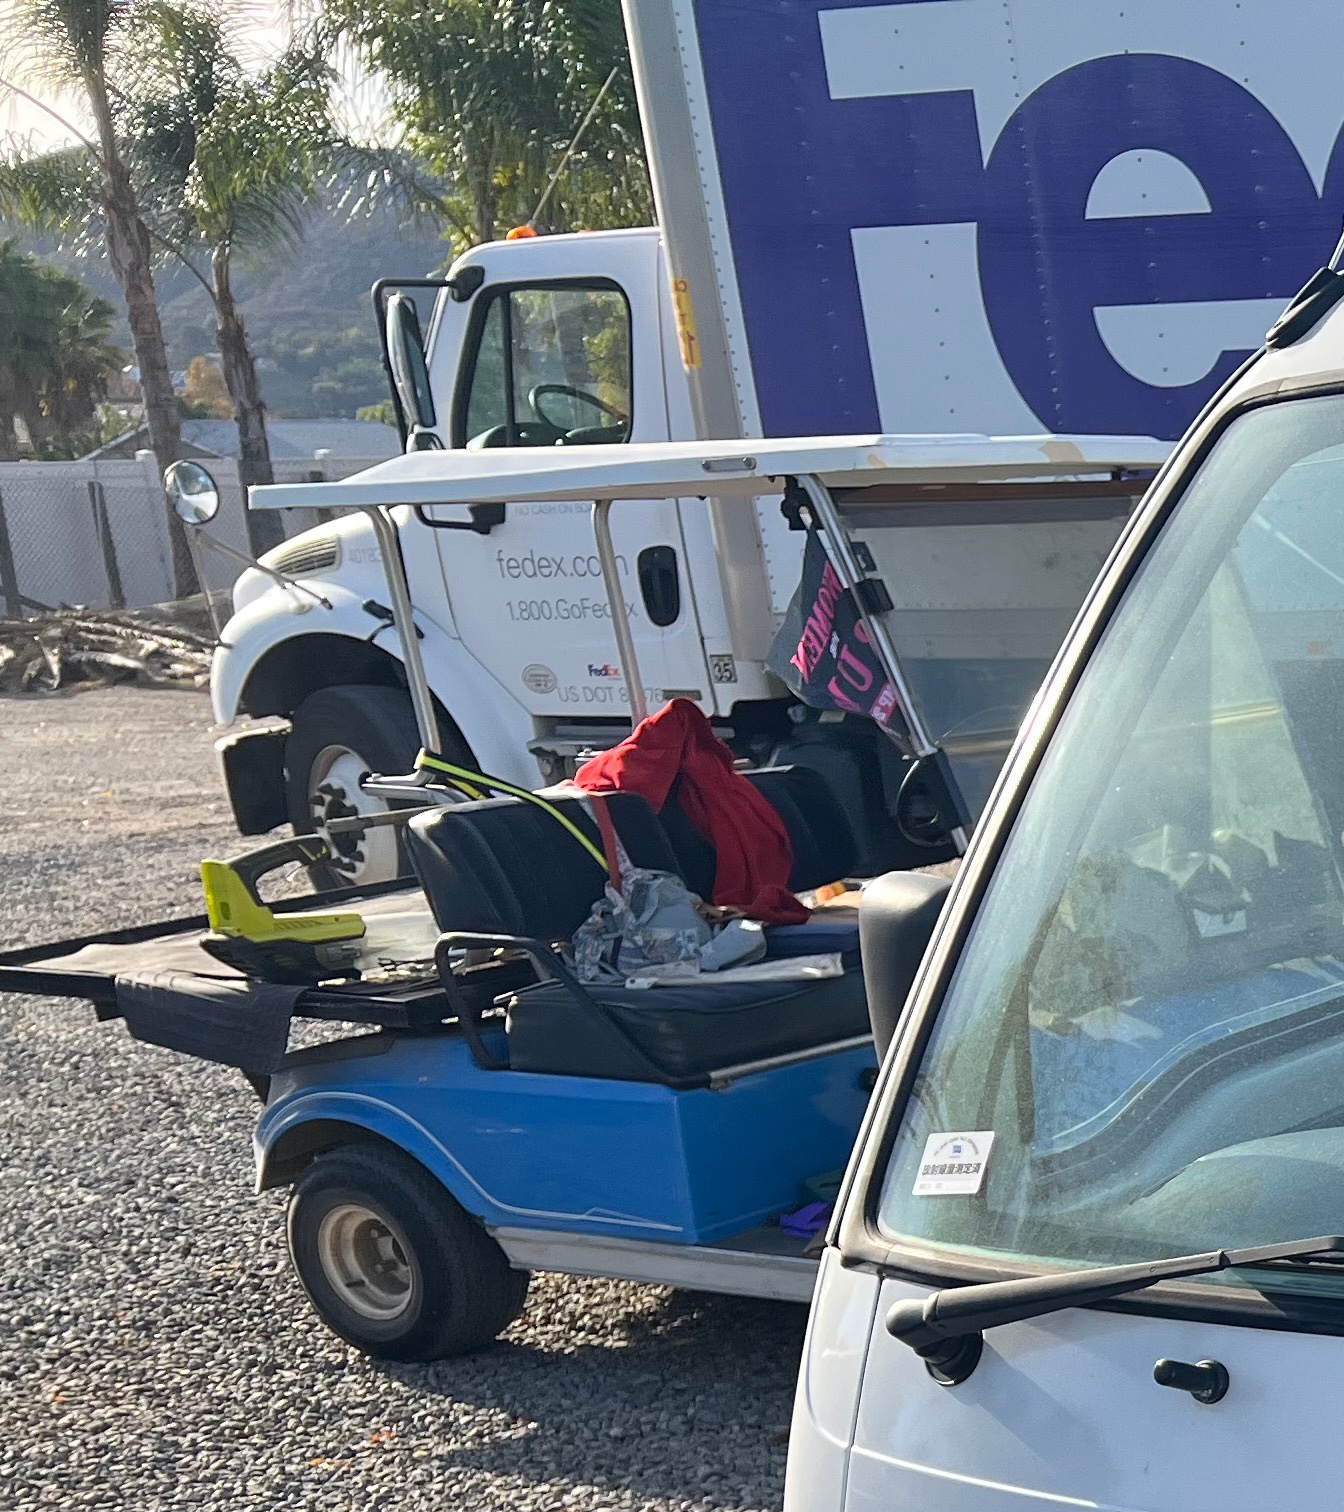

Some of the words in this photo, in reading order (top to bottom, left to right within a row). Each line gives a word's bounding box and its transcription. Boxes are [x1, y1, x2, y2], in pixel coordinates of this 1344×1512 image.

[505, 598, 639, 621] 1.800.GoFedx
[587, 663, 621, 678] FedEx
[557, 685, 580, 703] US
[582, 685, 614, 703] DOT
